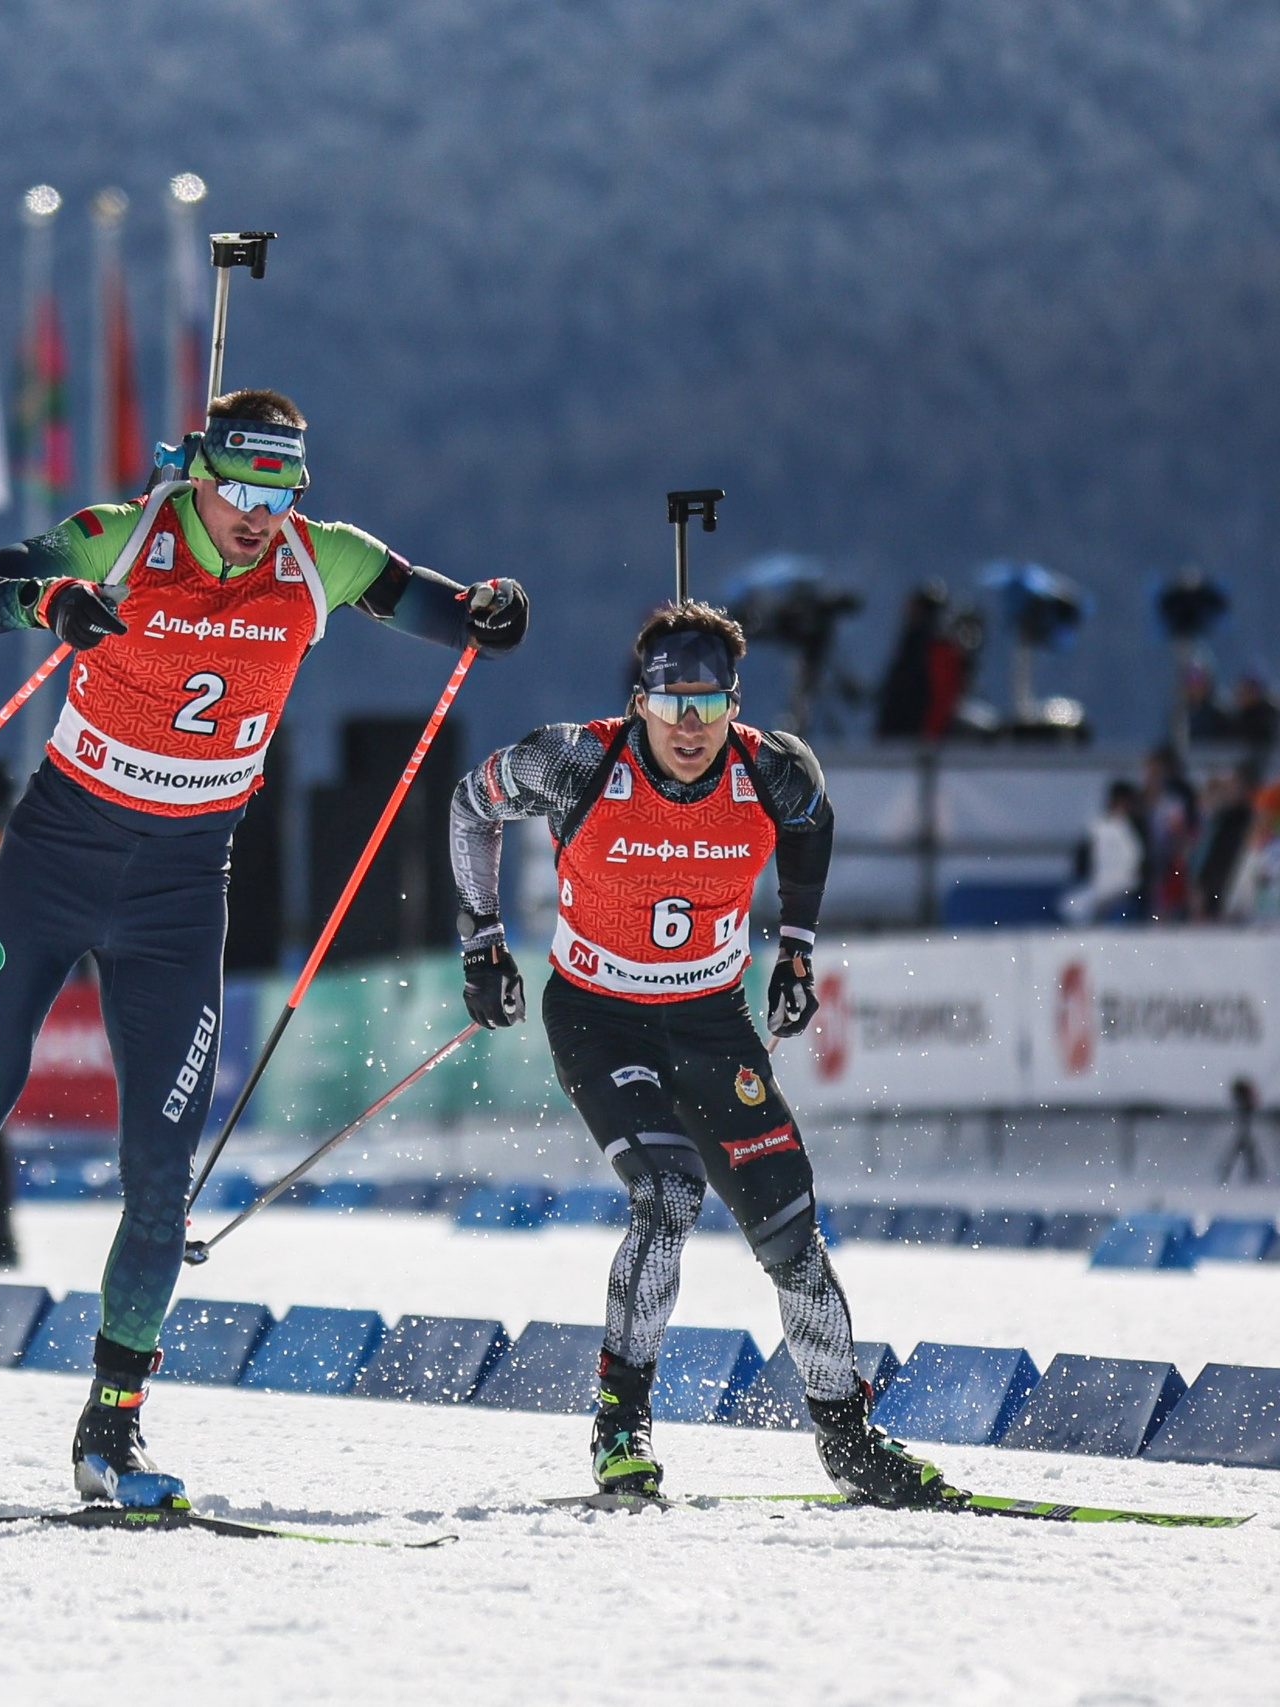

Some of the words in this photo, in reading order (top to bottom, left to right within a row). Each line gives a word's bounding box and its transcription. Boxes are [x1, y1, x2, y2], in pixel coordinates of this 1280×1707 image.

[144, 610, 225, 641] Альфа
[229, 618, 287, 642] Банк
[172, 671, 228, 735] 2
[246, 720, 257, 742] 1
[608, 838, 688, 862] Альфа
[693, 841, 750, 858] Банк
[561, 879, 574, 907] 6
[650, 896, 694, 950] 6
[723, 919, 730, 938] 1
[176, 1005, 217, 1094] BEEU
[733, 1142, 763, 1160] Альфа
[765, 1133, 790, 1147] Банк
